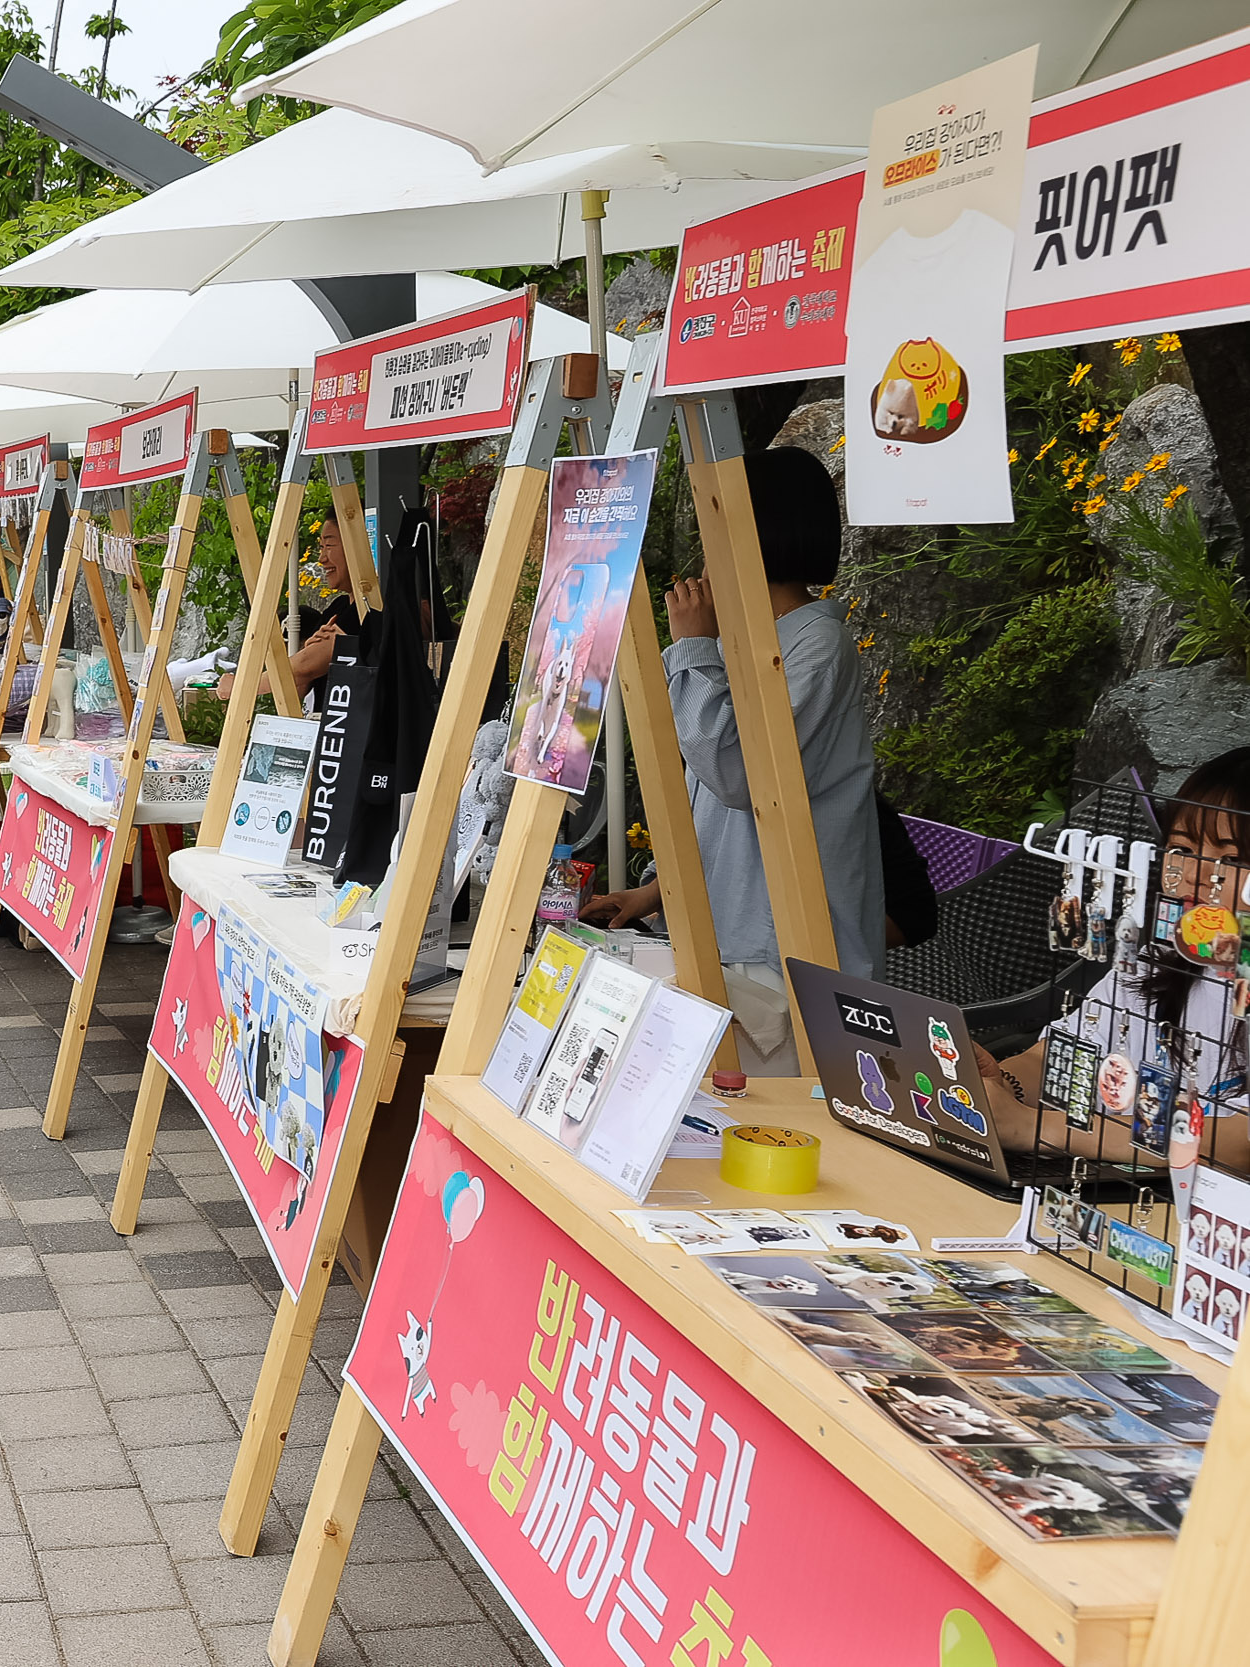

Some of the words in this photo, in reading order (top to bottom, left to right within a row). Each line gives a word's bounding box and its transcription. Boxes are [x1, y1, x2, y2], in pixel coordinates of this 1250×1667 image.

[903, 126, 938, 155] 우리집
[939, 108, 986, 144] 강아지가
[954, 131, 1002, 165] 된다면?!
[1033, 143, 1181, 271] 핏어팻
[684, 253, 745, 303] 반려동물과
[747, 238, 807, 288] 함께하는
[811, 226, 846, 273] 축제
[733, 309, 748, 326] KU
[408, 378, 439, 416] 장바구니
[563, 507, 581, 523] 지금
[581, 507, 590, 523] 이
[588, 506, 609, 523] 순간을
[609, 505, 638, 521] 간직해요
[575, 488, 600, 505] 우리집
[600, 485, 635, 503] 강아지와의
[33, 807, 74, 872] 반려동물과
[21, 854, 59, 918] 함께하는
[52, 876, 75, 931] 축제
[542, 900, 573, 909] 아이시스
[833, 1099, 865, 1121] Google
[865, 1110, 878, 1125] for
[877, 1115, 930, 1146] Developers
[940, 1090, 986, 1135] LGTM
[528, 1259, 757, 1576] 반려동물과
[488, 1382, 668, 1667] 함께하는
